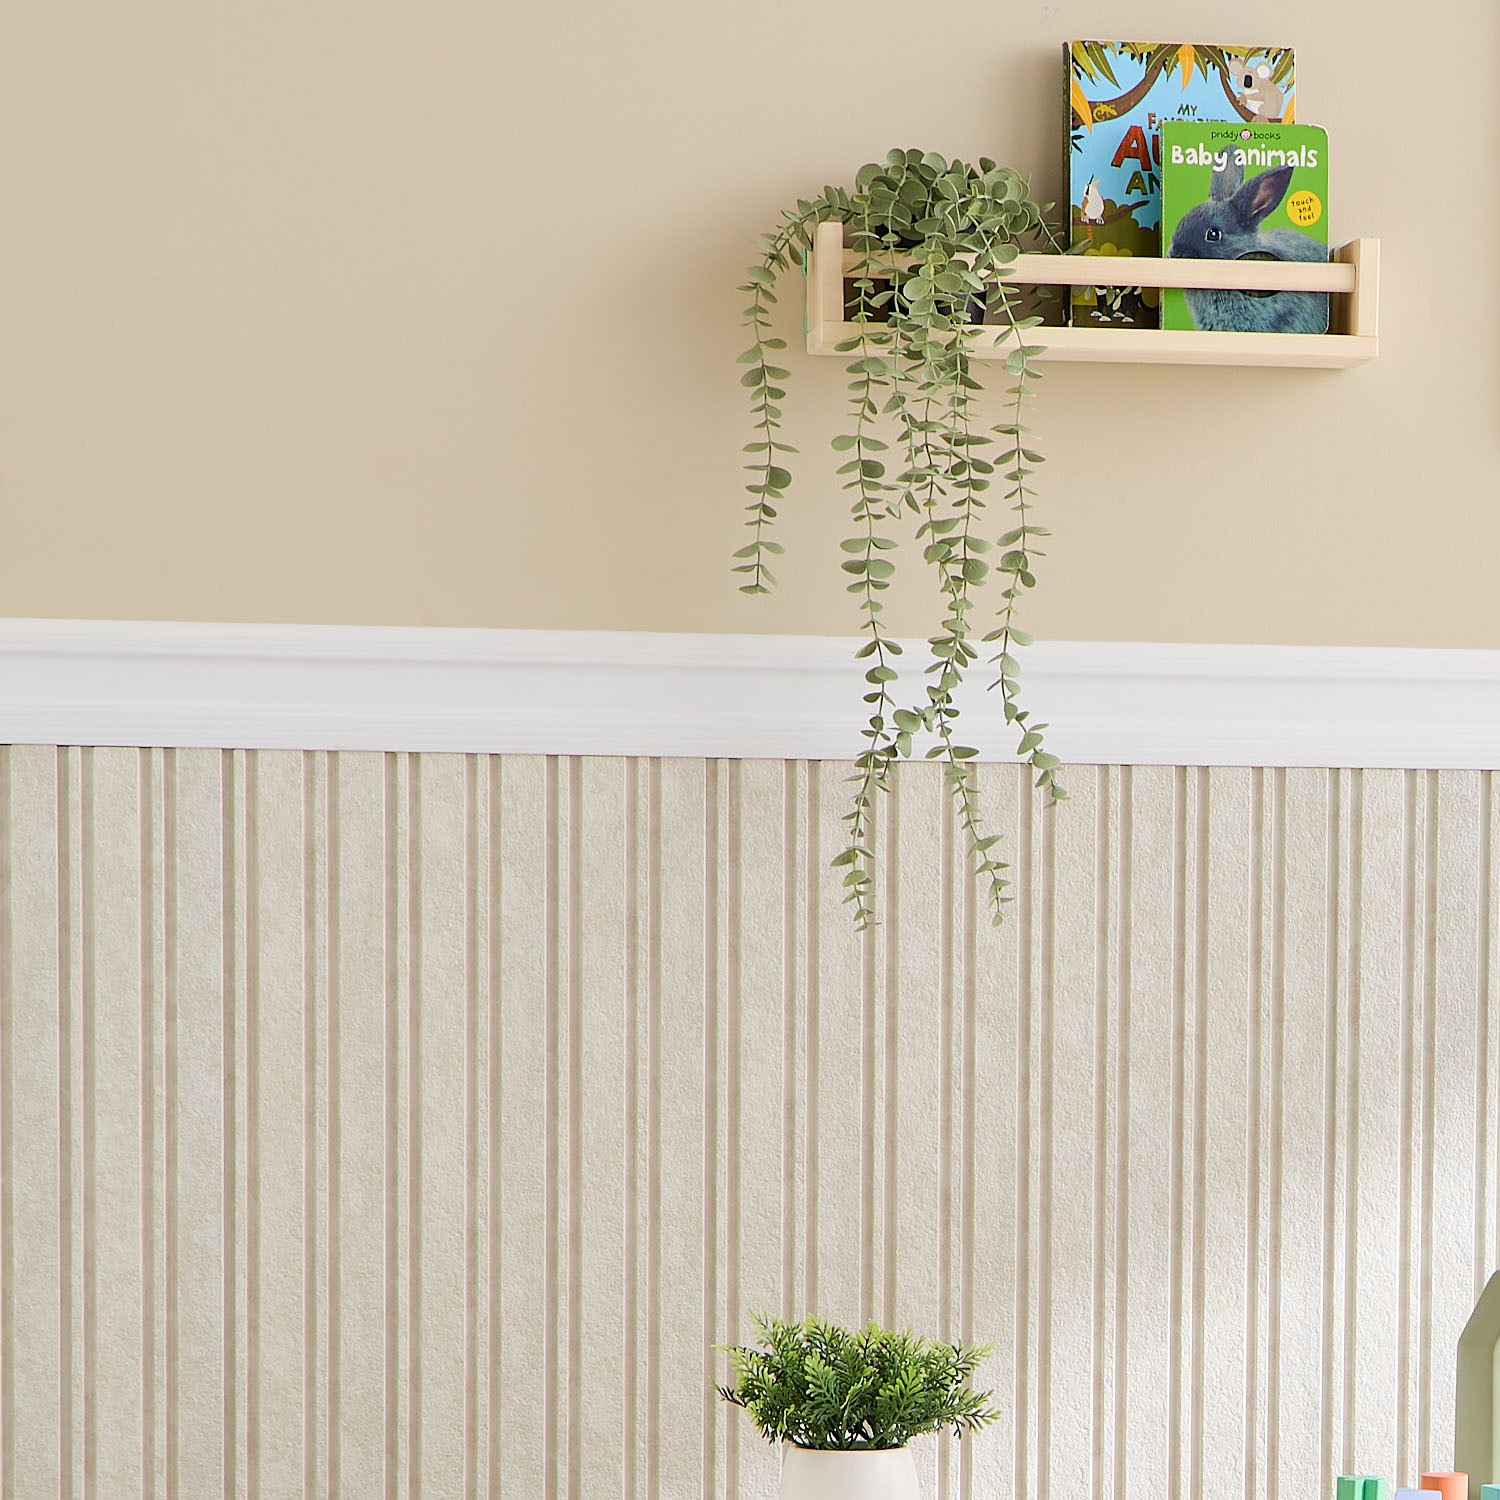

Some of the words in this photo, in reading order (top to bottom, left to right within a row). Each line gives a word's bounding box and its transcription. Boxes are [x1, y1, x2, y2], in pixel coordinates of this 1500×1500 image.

[1177, 103, 1198, 117] MY
[1211, 130, 1239, 143] priddy
[1253, 131, 1281, 140] books
[1171, 142, 1229, 173] Baby
[1233, 143, 1319, 169] animals
